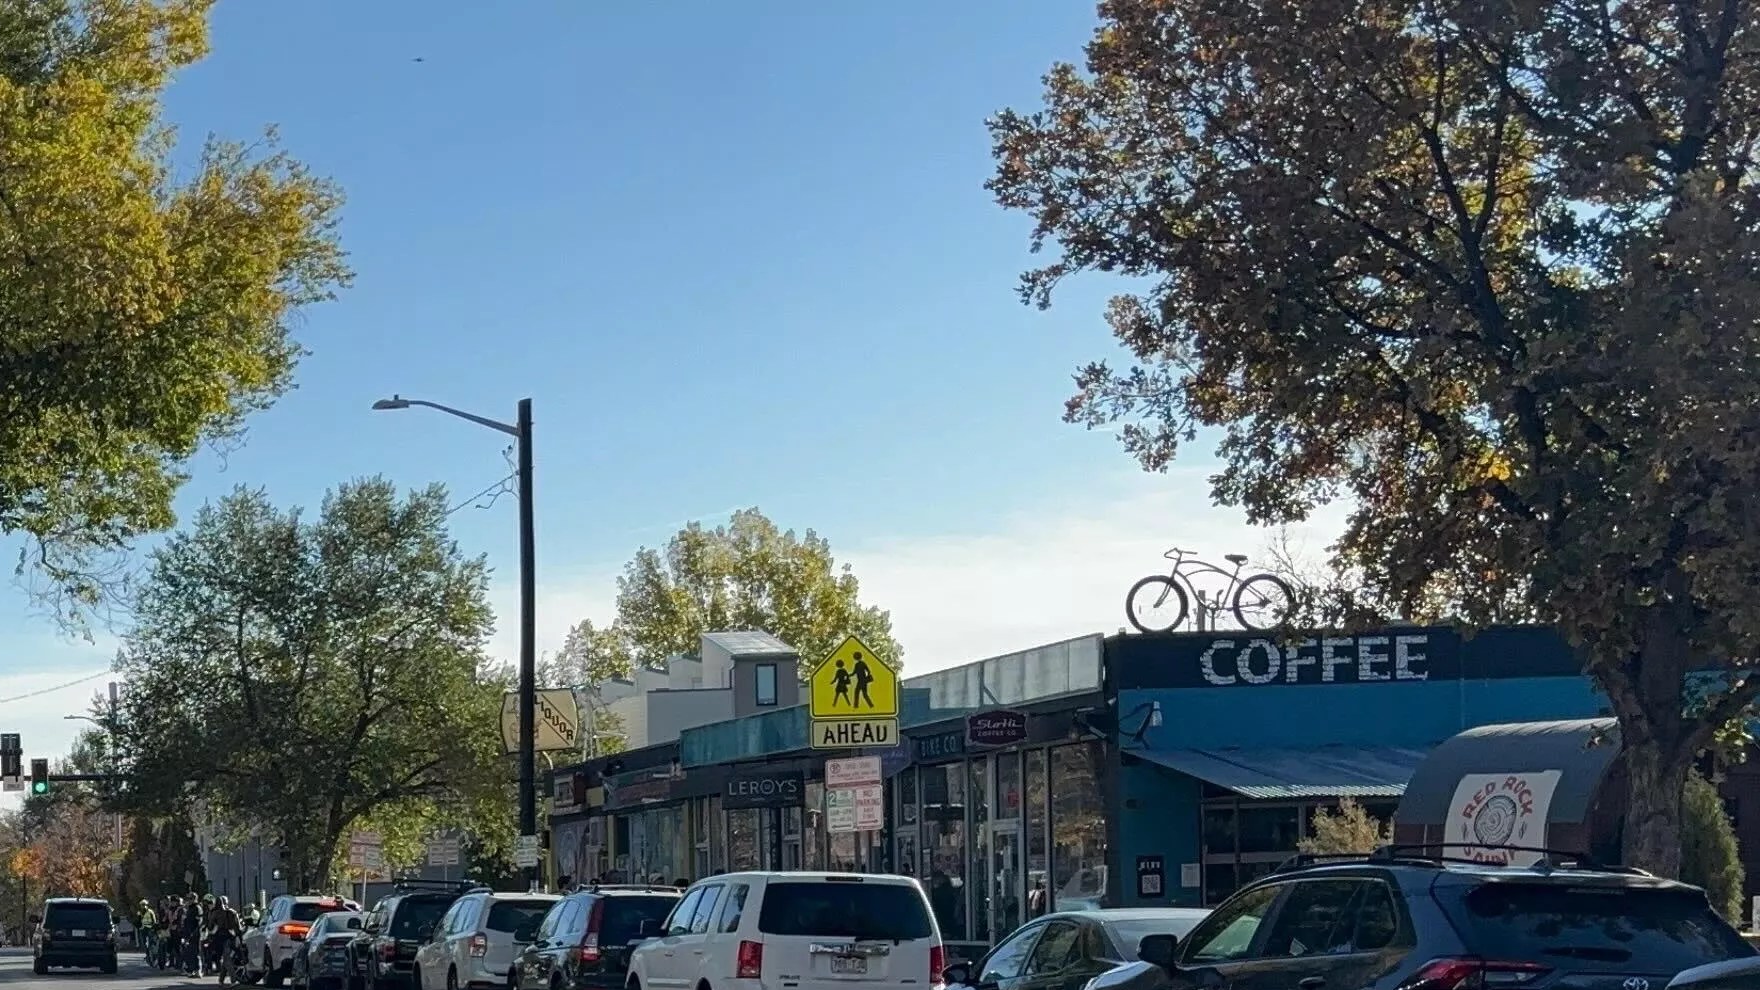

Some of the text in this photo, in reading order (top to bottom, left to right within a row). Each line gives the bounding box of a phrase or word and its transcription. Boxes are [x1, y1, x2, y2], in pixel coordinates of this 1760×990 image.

[1200, 635, 1428, 685] COFFEE
[534, 694, 574, 740] LIQUOR
[823, 723, 888, 744] AHEAD
[728, 779, 798, 797] LEROY'S
[1462, 775, 1534, 819] RED ROCK
